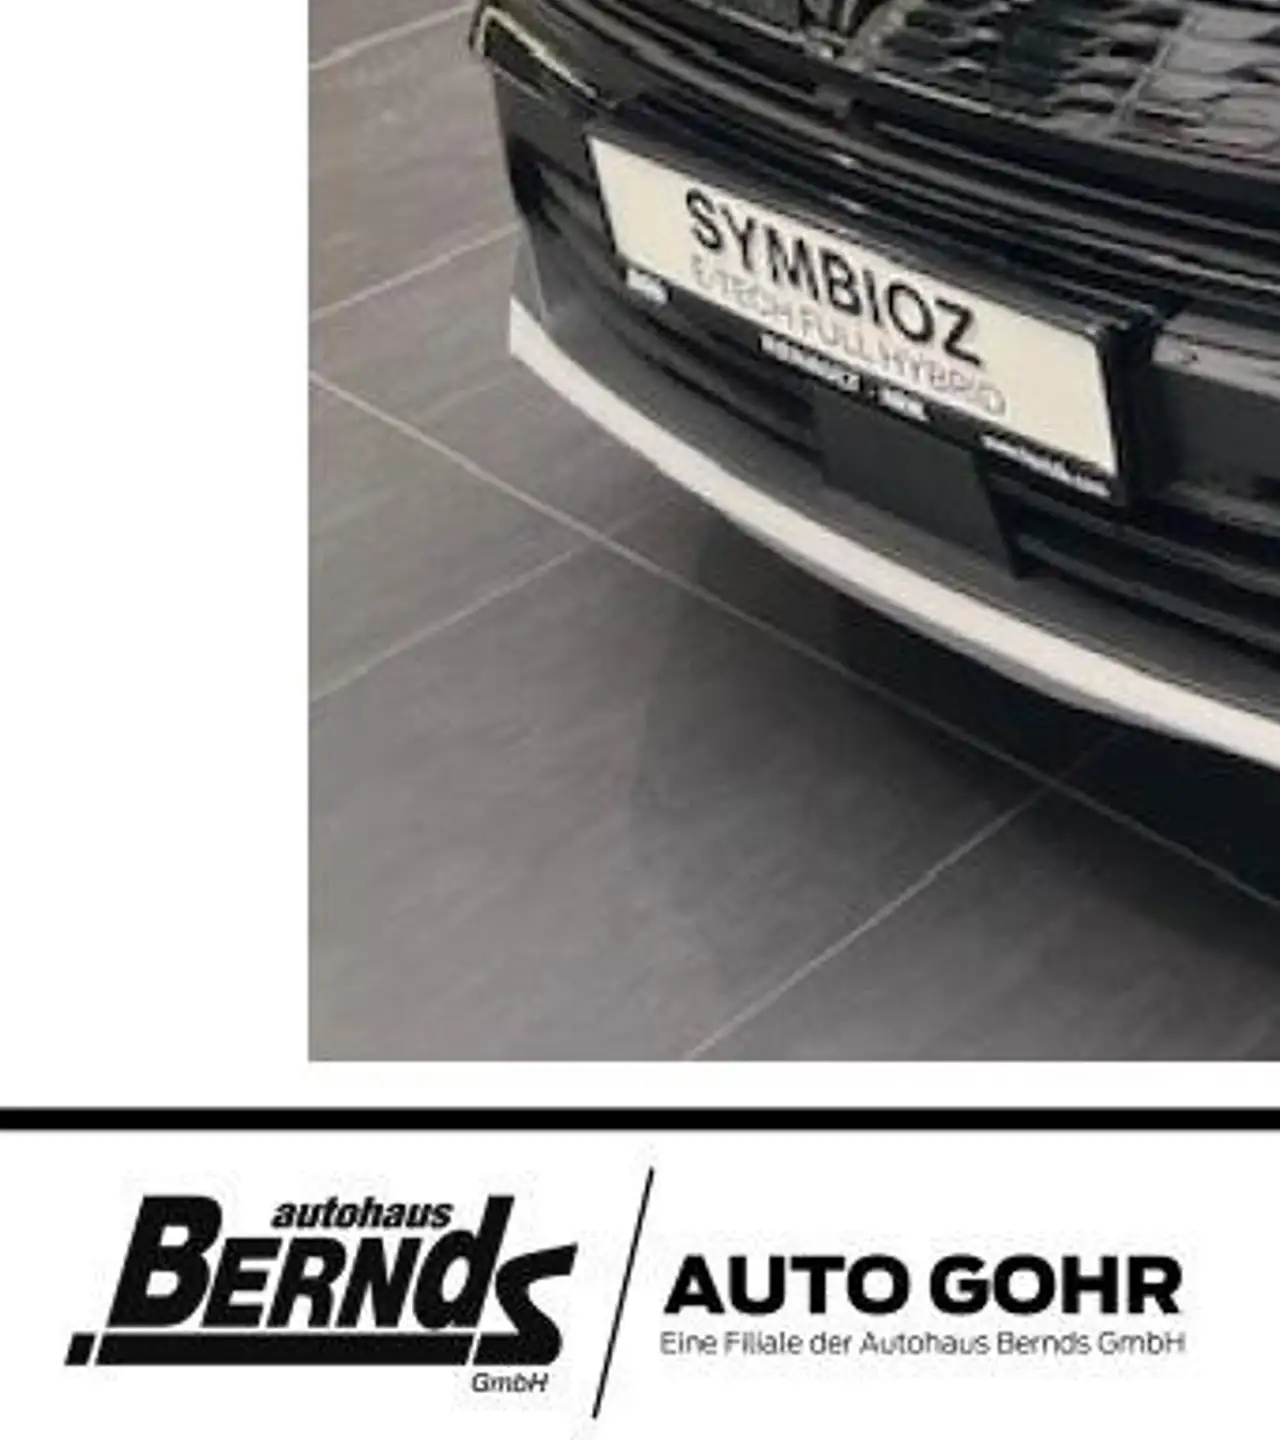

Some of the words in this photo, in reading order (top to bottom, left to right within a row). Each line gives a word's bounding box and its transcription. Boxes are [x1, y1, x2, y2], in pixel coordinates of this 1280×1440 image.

[684, 187, 984, 365] SYMBIOZ
[798, 304, 872, 364] FULL
[874, 338, 1007, 417] HYBRID
